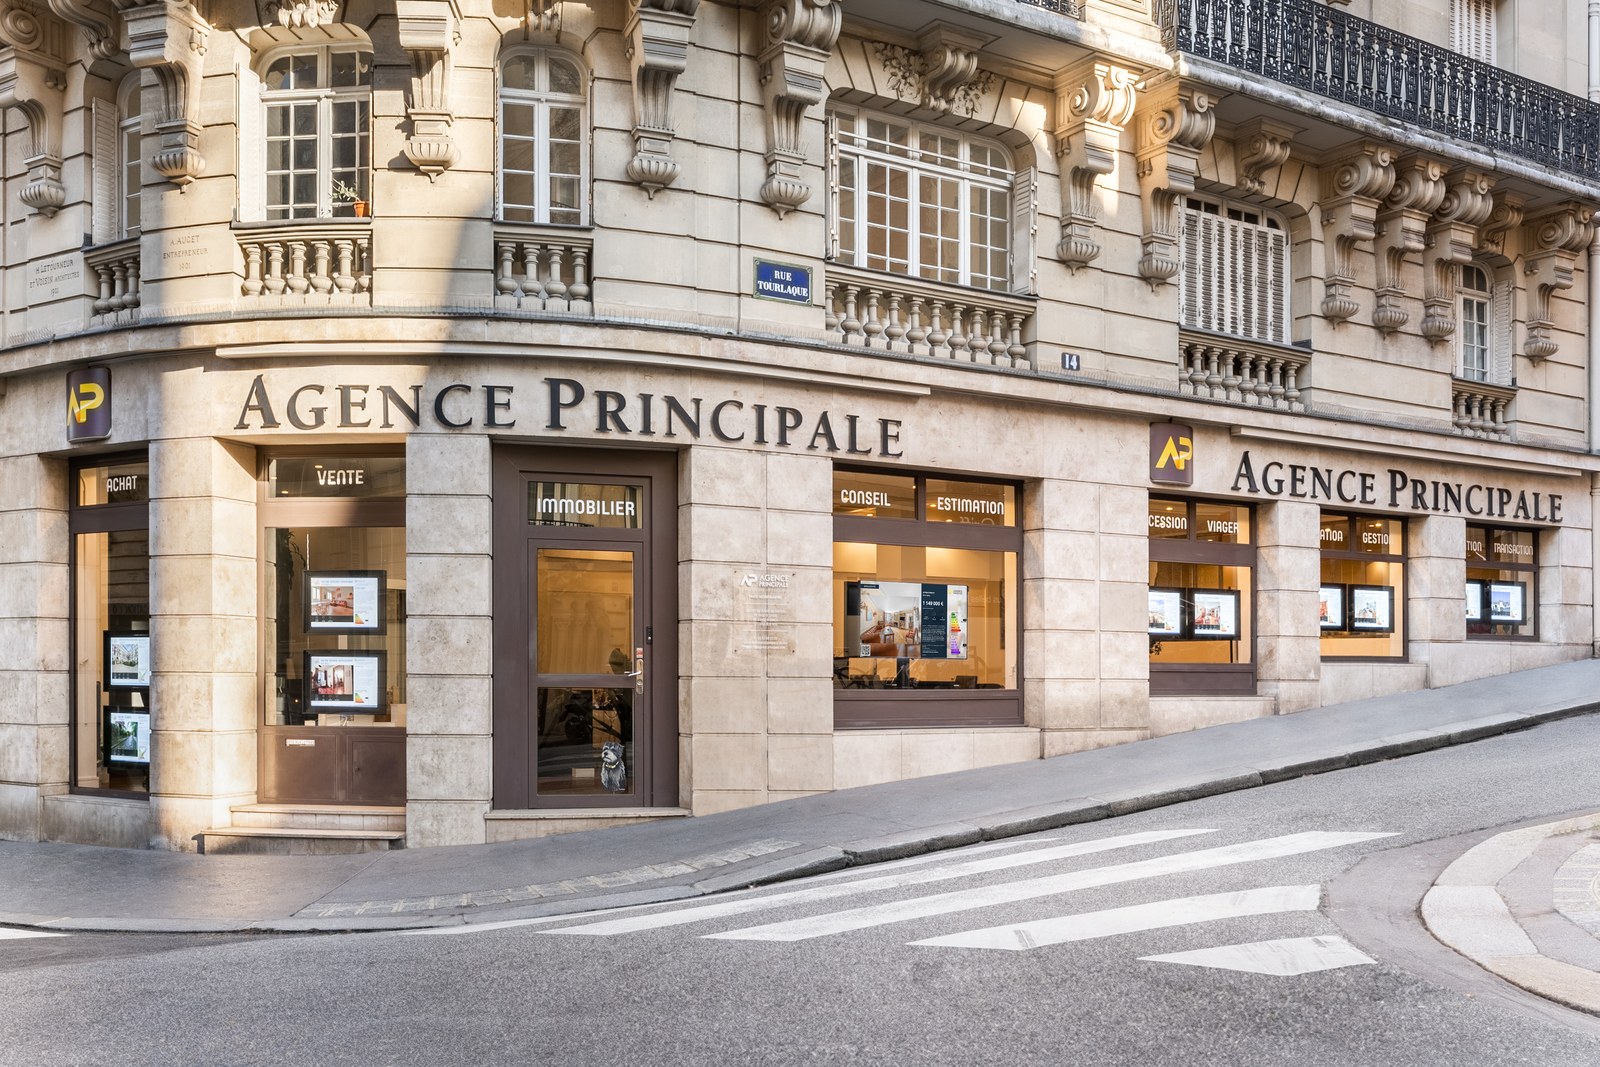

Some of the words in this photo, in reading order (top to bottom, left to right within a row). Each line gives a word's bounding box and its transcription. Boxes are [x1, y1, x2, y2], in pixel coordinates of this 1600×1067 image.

[774, 270, 792, 282] RUE
[757, 280, 808, 297] TOURLAQUE
[1065, 353, 1078, 370] 14
[67, 382, 105, 426] AP
[234, 373, 516, 431] AGENCE
[544, 377, 905, 458] PRINCIPALE
[1155, 435, 1193, 471] AP
[106, 475, 138, 493] ACHAT
[317, 469, 364, 486] VENTE
[1230, 450, 1377, 505] AGENCE
[1387, 469, 1564, 523] PRINCIPALE
[537, 497, 636, 517] IMMOBILIER
[841, 489, 891, 507] CONSEIL
[937, 496, 1005, 515] ESTIMATION
[1149, 514, 1188, 530] CESSION
[1207, 519, 1239, 534] VIAGER
[1493, 542, 1534, 556] TRANSACTION
